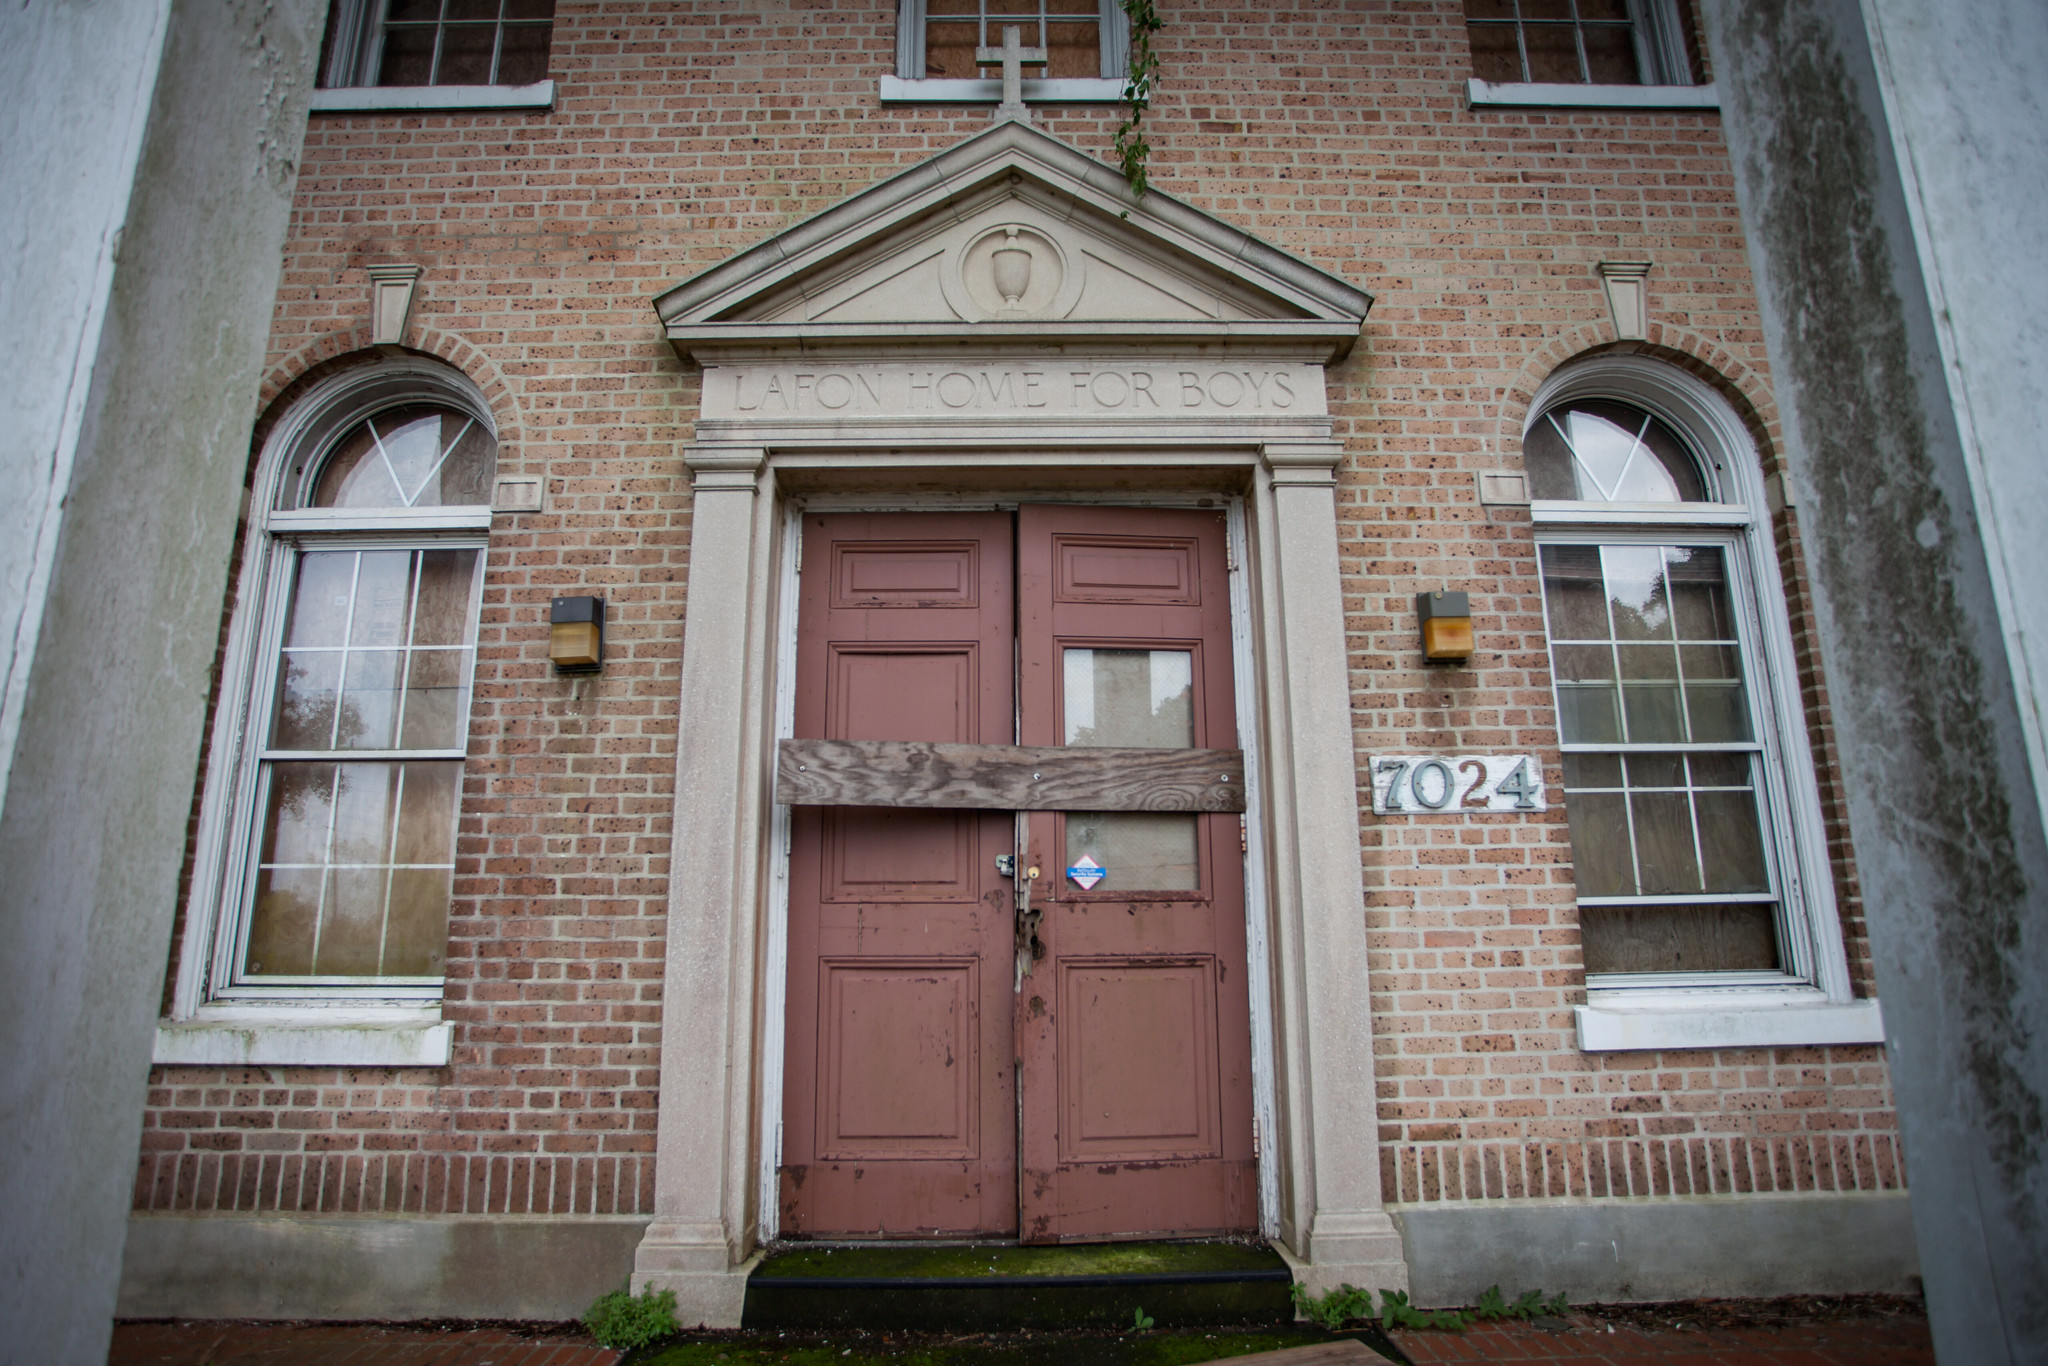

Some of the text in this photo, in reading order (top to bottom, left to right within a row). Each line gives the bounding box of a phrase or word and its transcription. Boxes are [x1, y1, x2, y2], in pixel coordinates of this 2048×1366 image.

[733, 370, 1296, 411] LAFON HOME FOR BOYS
[1377, 757, 1539, 810] 7024
